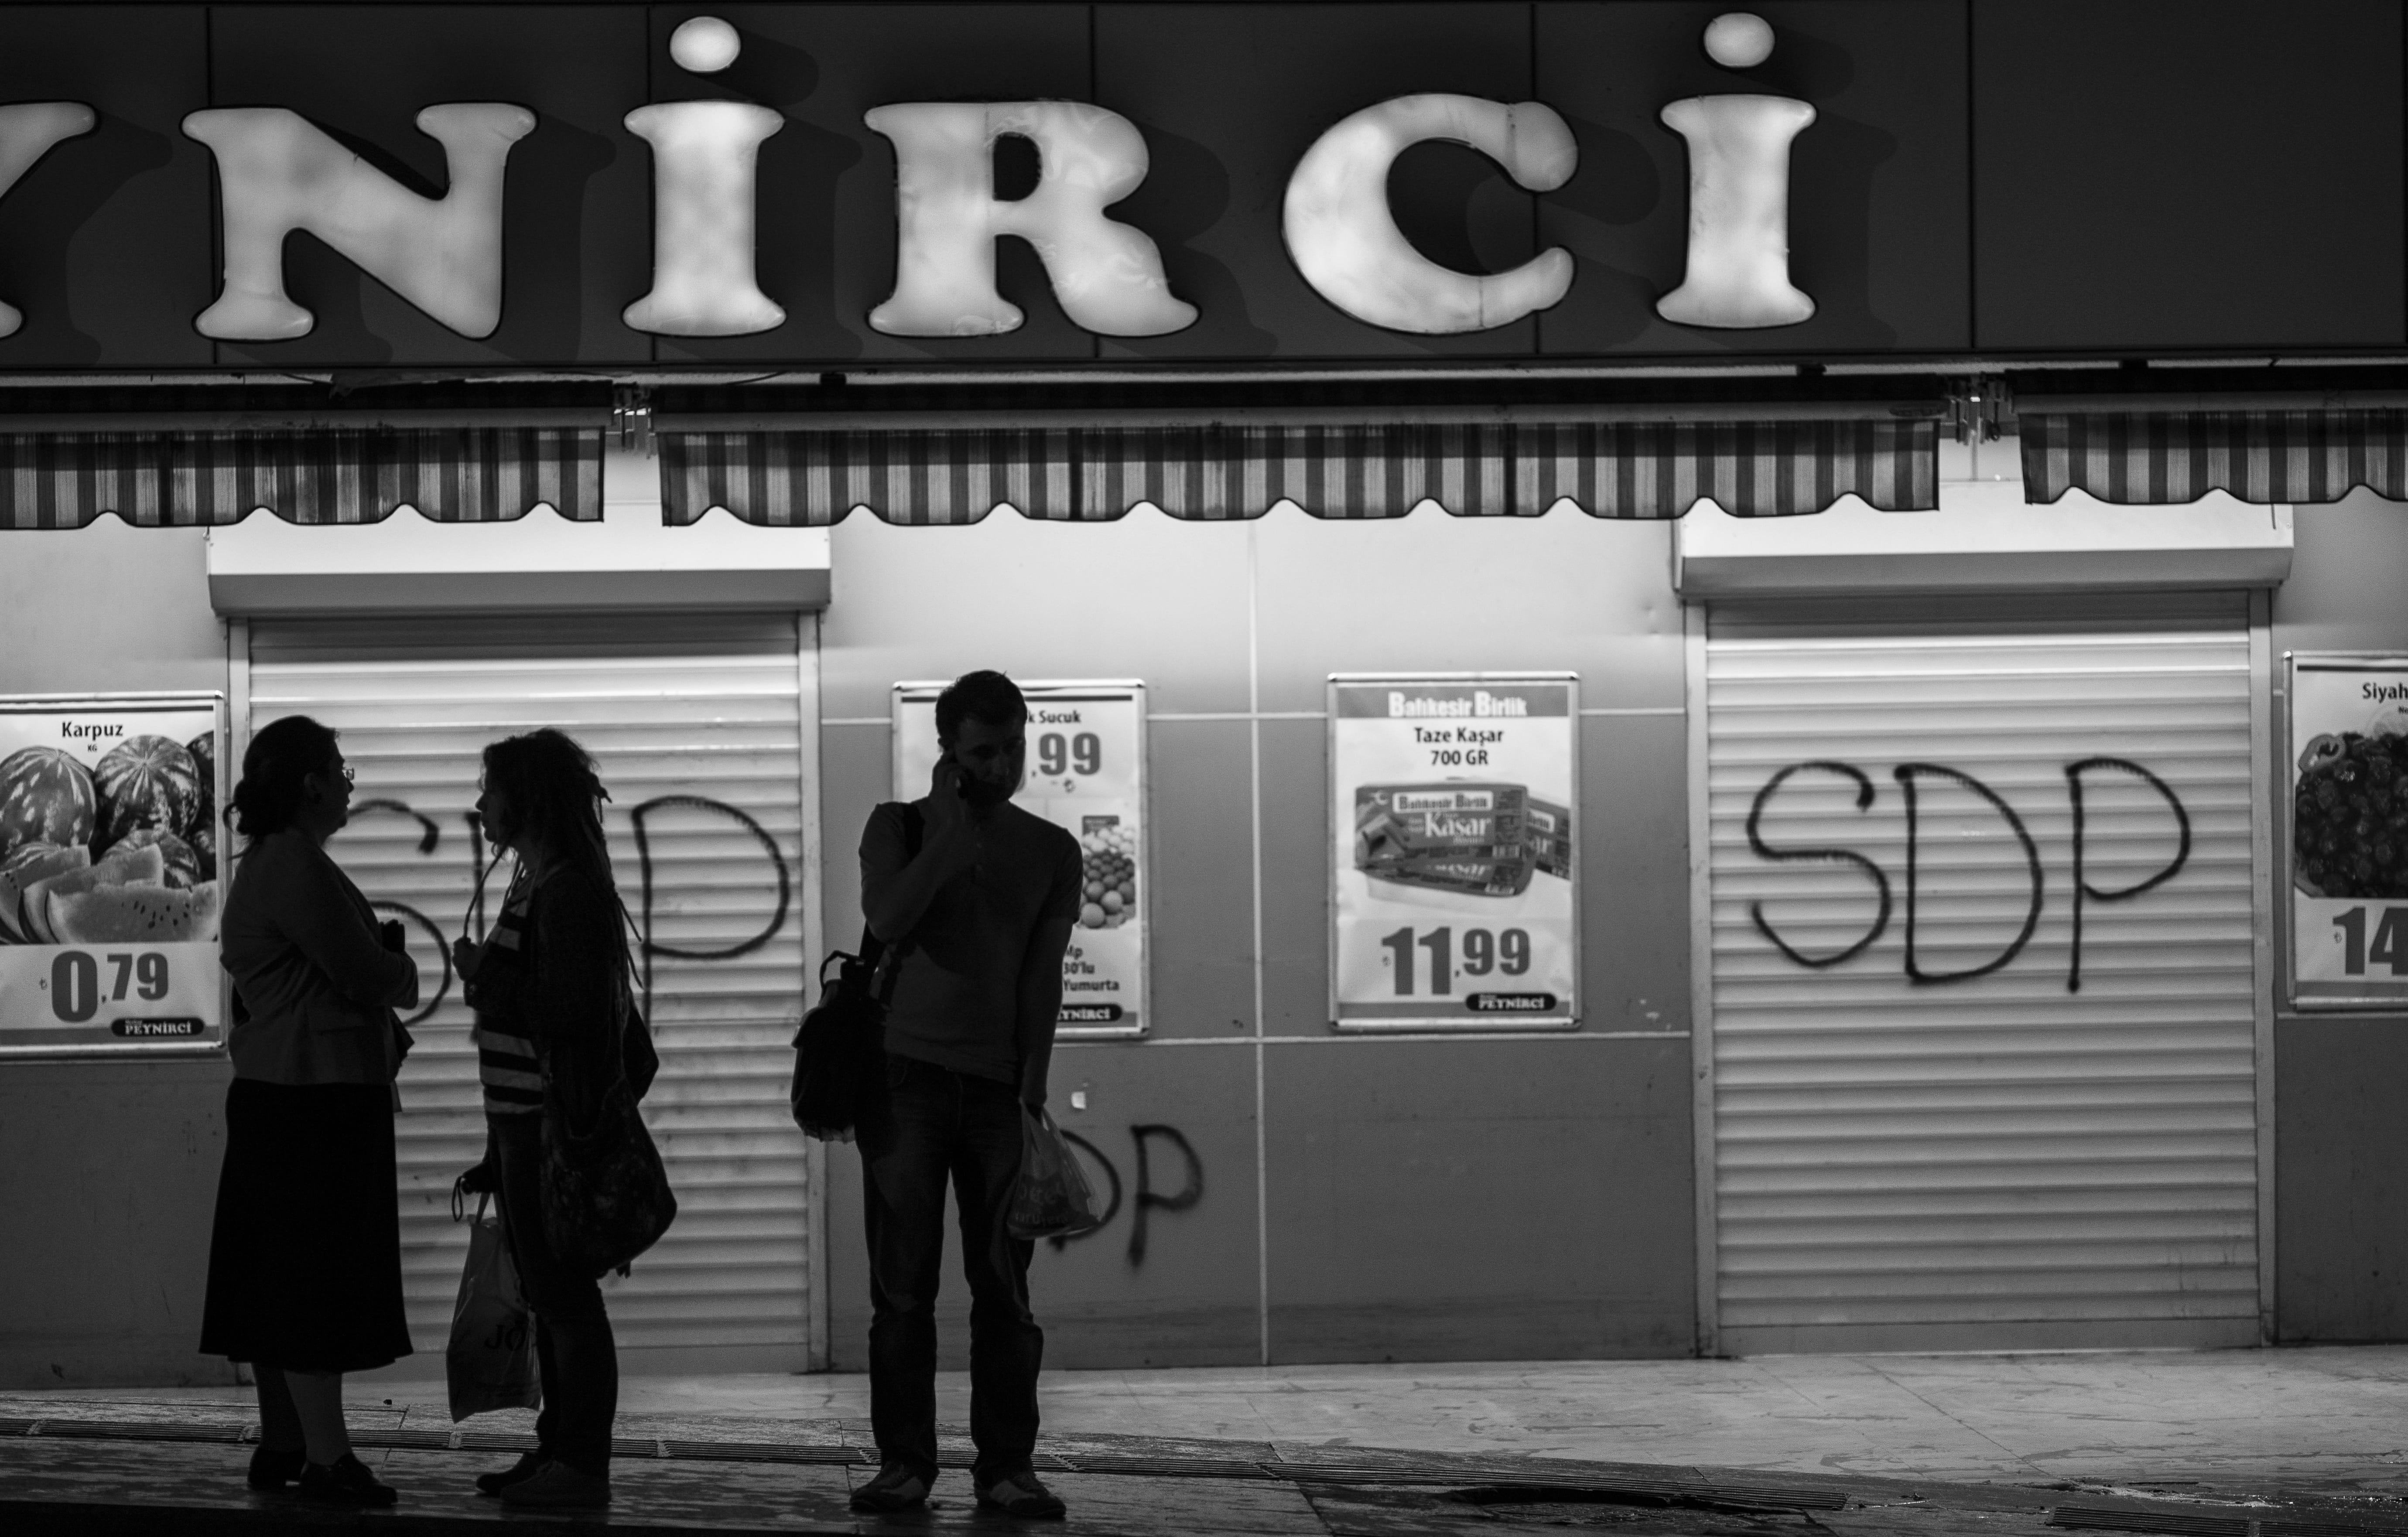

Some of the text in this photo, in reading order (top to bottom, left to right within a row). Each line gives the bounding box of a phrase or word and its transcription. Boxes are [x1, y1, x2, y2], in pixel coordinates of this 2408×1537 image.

[2363, 682, 2408, 703] Siyah
[1474, 690, 1527, 716] Birlik
[1039, 709, 1081, 723] Sucuk
[62, 721, 123, 741] Karpuz
[1414, 726, 1504, 746] Taze Kaşar
[1430, 749, 1488, 765] 700 GR
[1746, 756, 2191, 993] SDP
[1057, 1007, 1110, 1020] YNİRCİ
[125, 1020, 192, 1035] PEYNİRCİ
